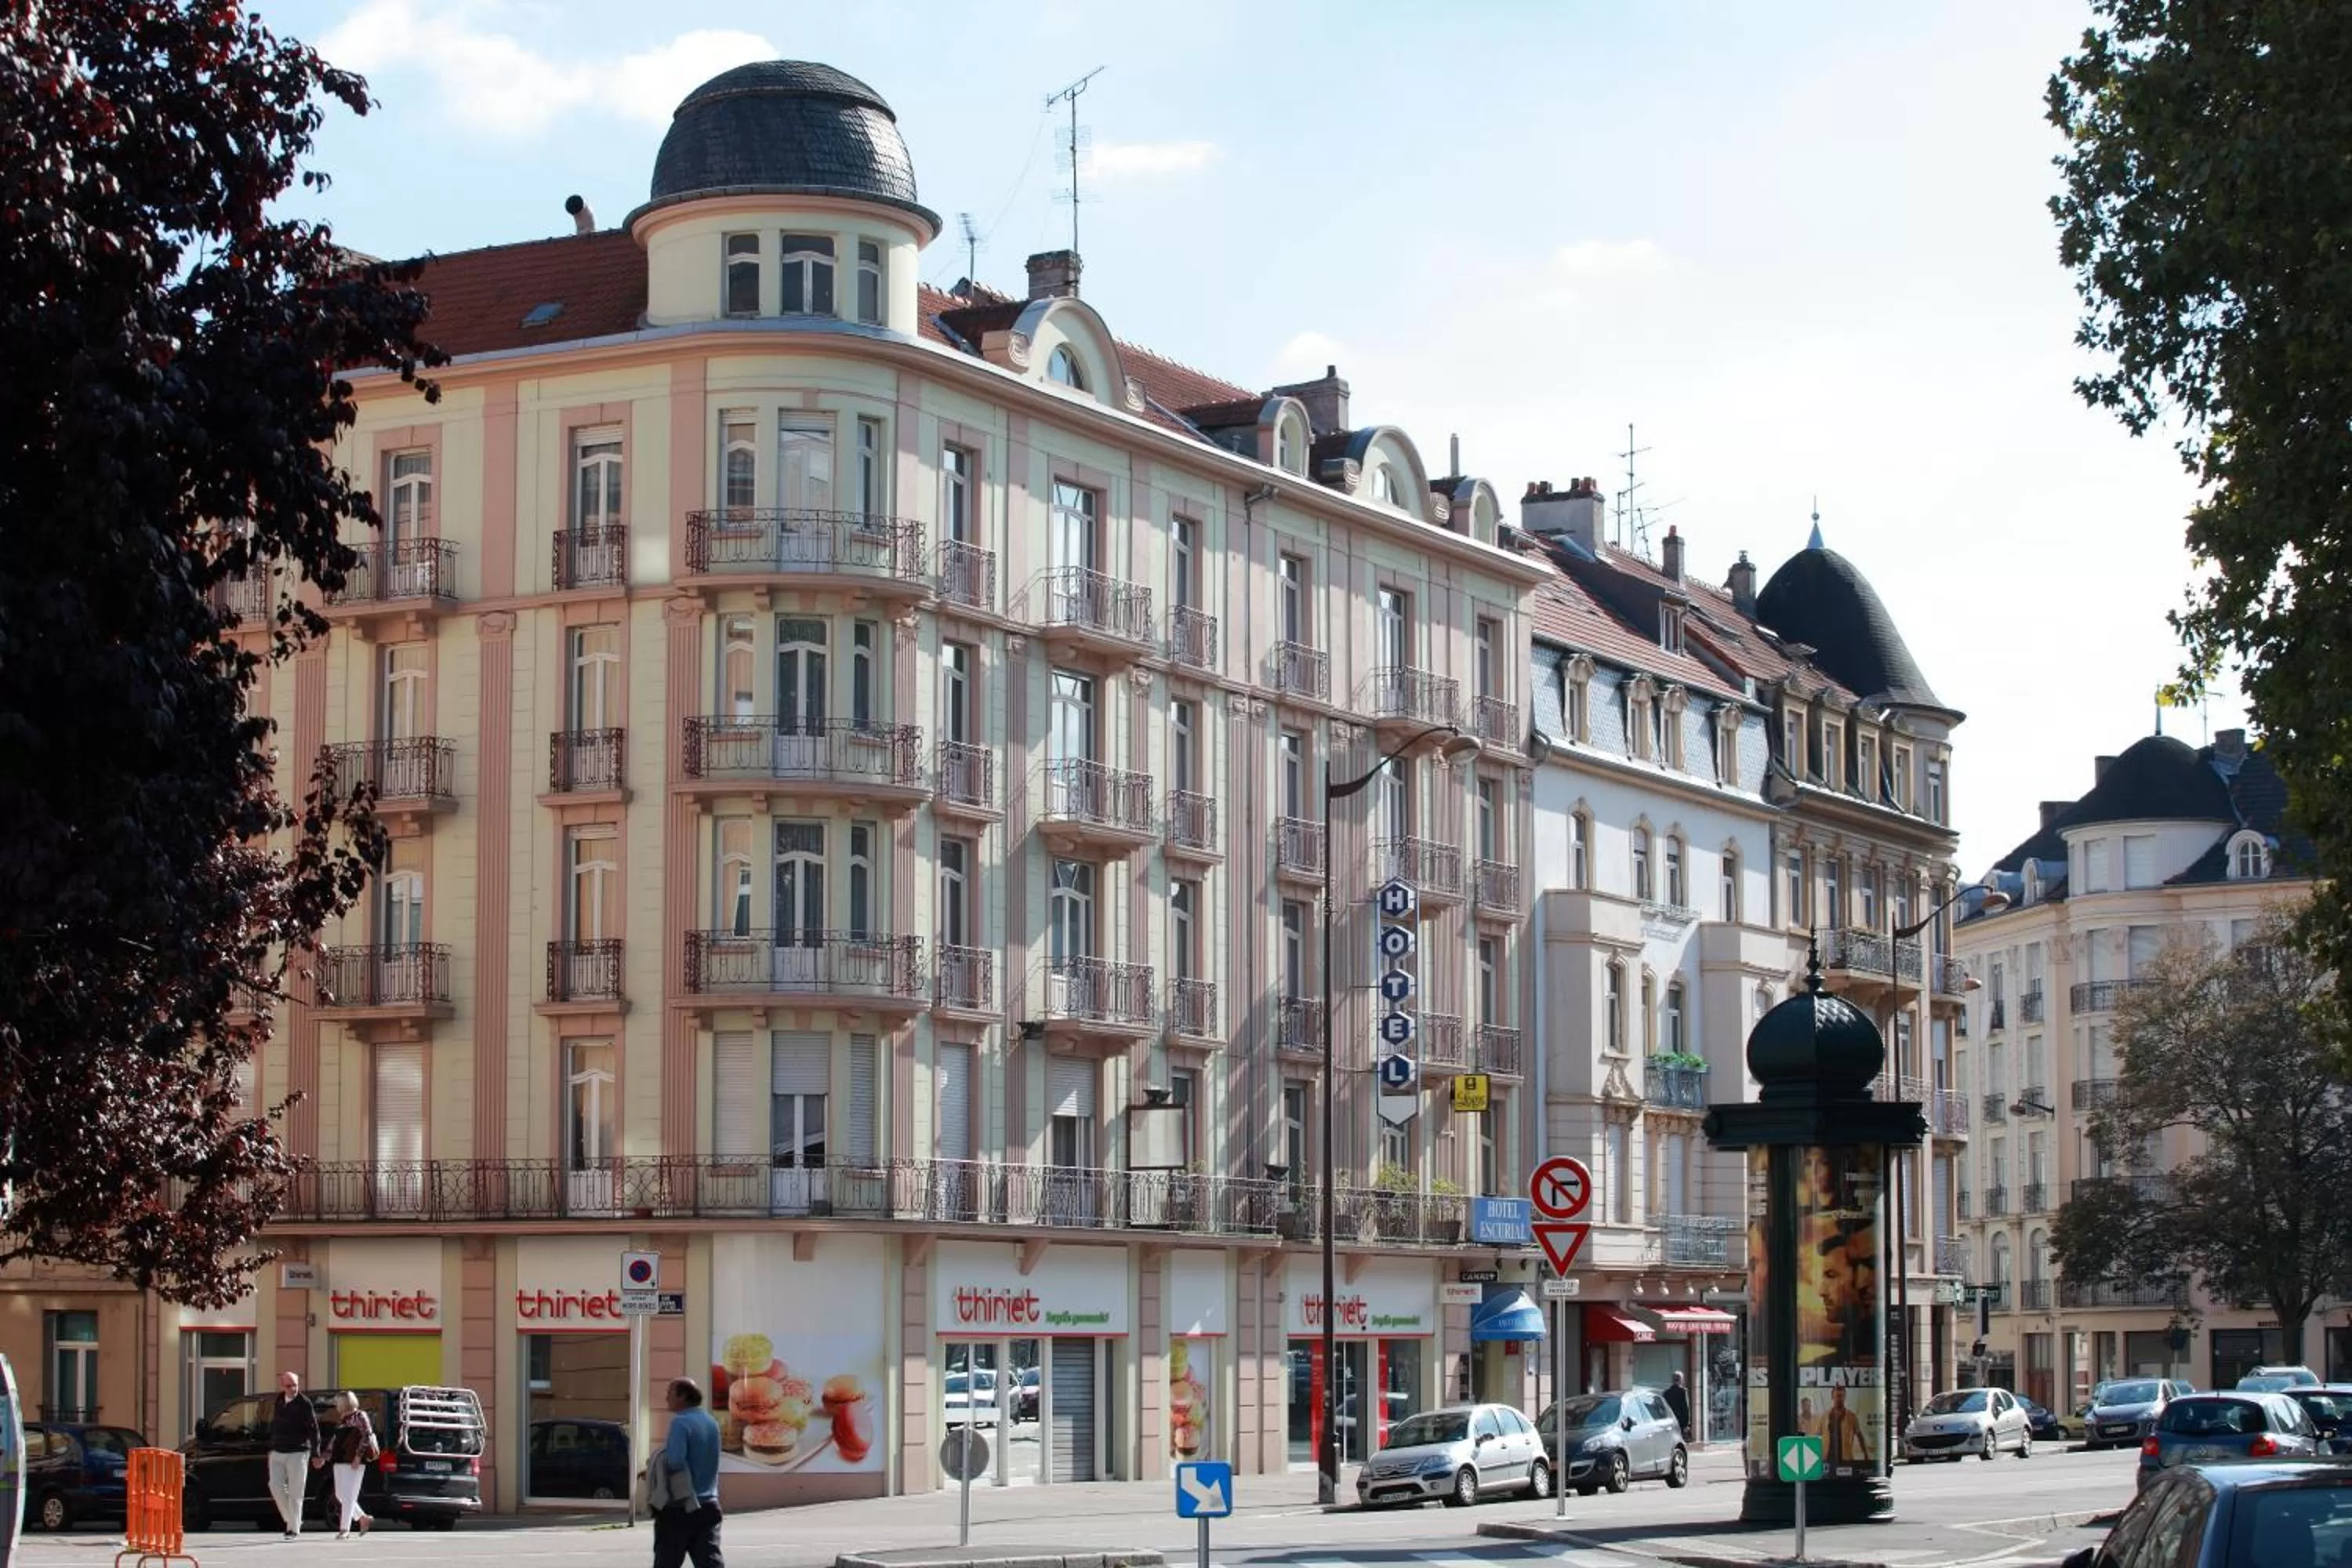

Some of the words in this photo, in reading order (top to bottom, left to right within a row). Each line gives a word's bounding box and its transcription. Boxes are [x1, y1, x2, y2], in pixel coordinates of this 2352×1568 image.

[1385, 889, 1403, 1081] HOTEL
[1487, 1200, 1520, 1218] HOTEL
[1479, 1221, 1526, 1240] ESCURIAL
[330, 1290, 440, 1318] thiriet
[516, 1289, 624, 1318] thiriet
[956, 1287, 1040, 1323] thiriet
[1304, 1294, 1367, 1325] thriet
[1799, 1367, 1884, 1387] PLAYER
